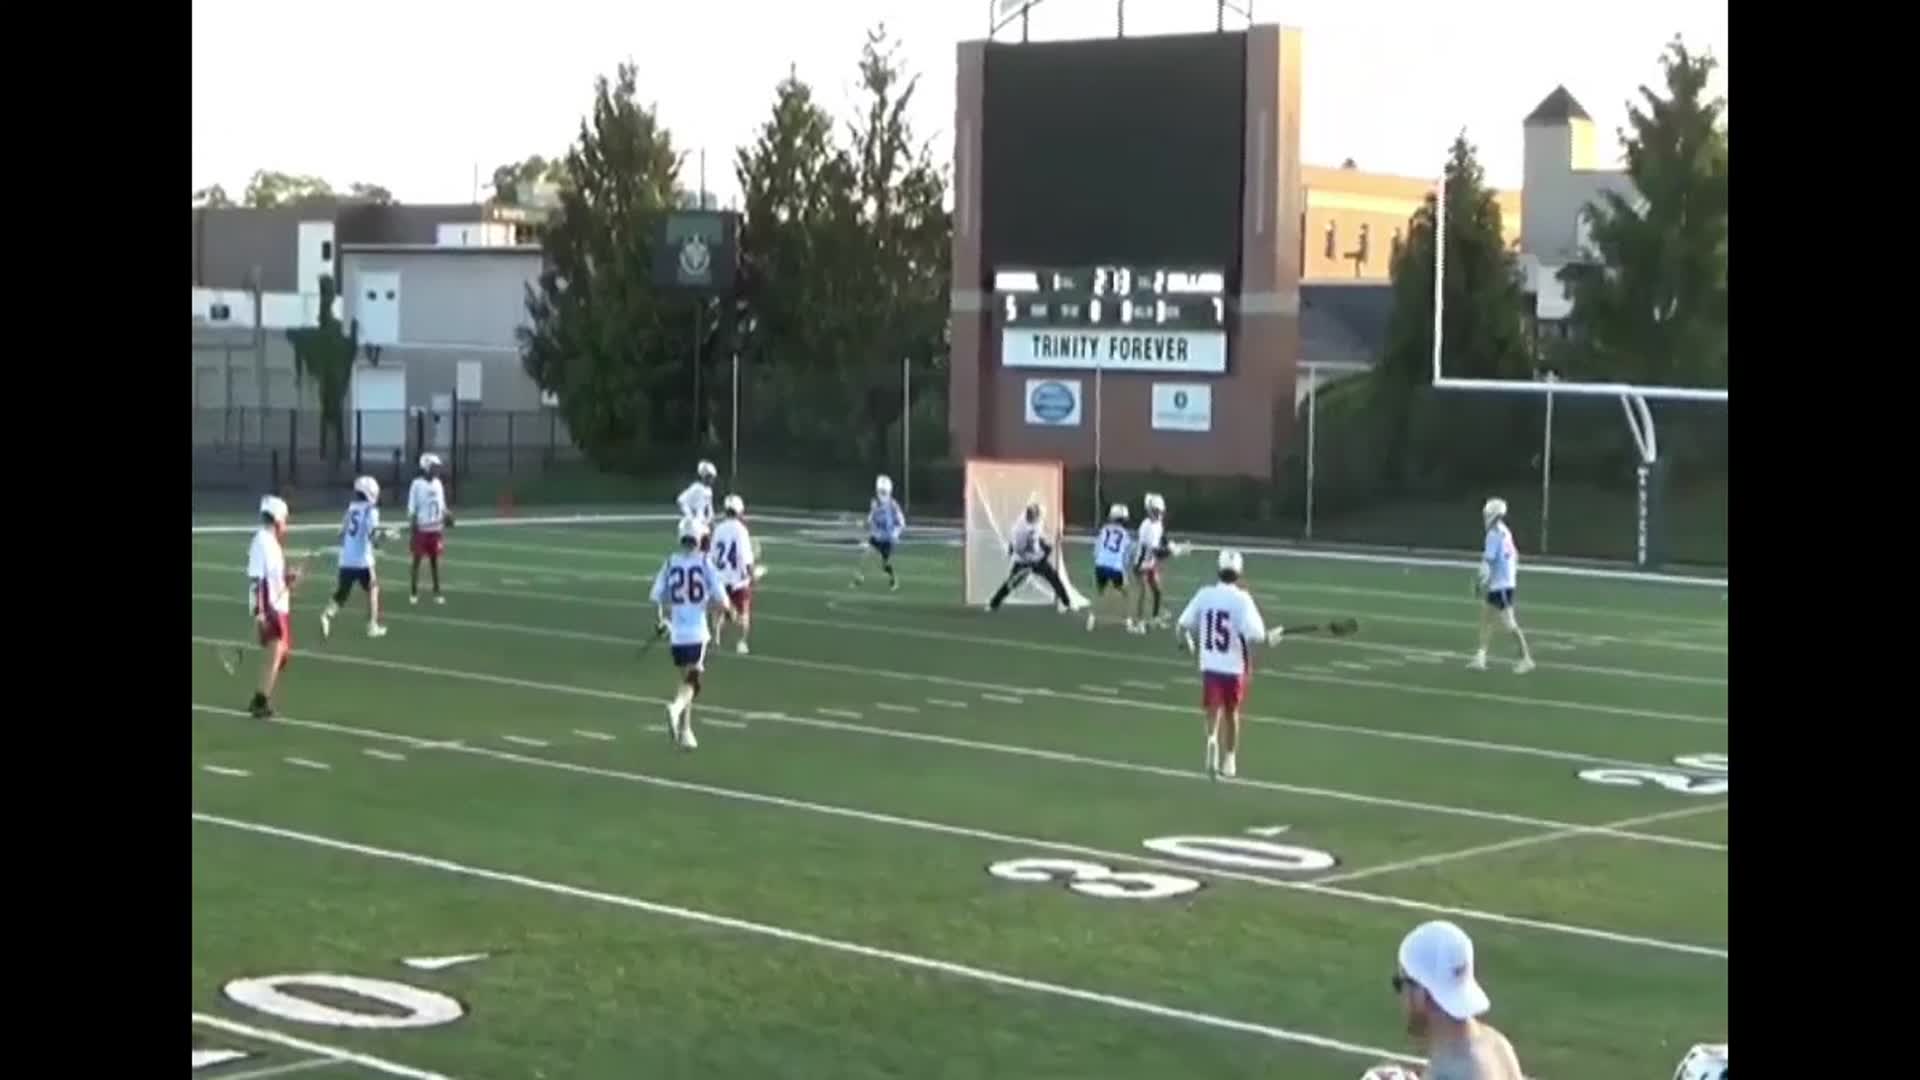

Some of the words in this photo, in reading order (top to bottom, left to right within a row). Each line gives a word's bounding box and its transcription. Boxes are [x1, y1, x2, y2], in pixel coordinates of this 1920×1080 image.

[1032, 334, 1099, 358] TRINITY
[1108, 336, 1189, 361] FOREVER
[714, 541, 737, 570] 24
[1103, 530, 1124, 553] 13
[670, 565, 705, 604] 26
[1205, 608, 1231, 653] 15
